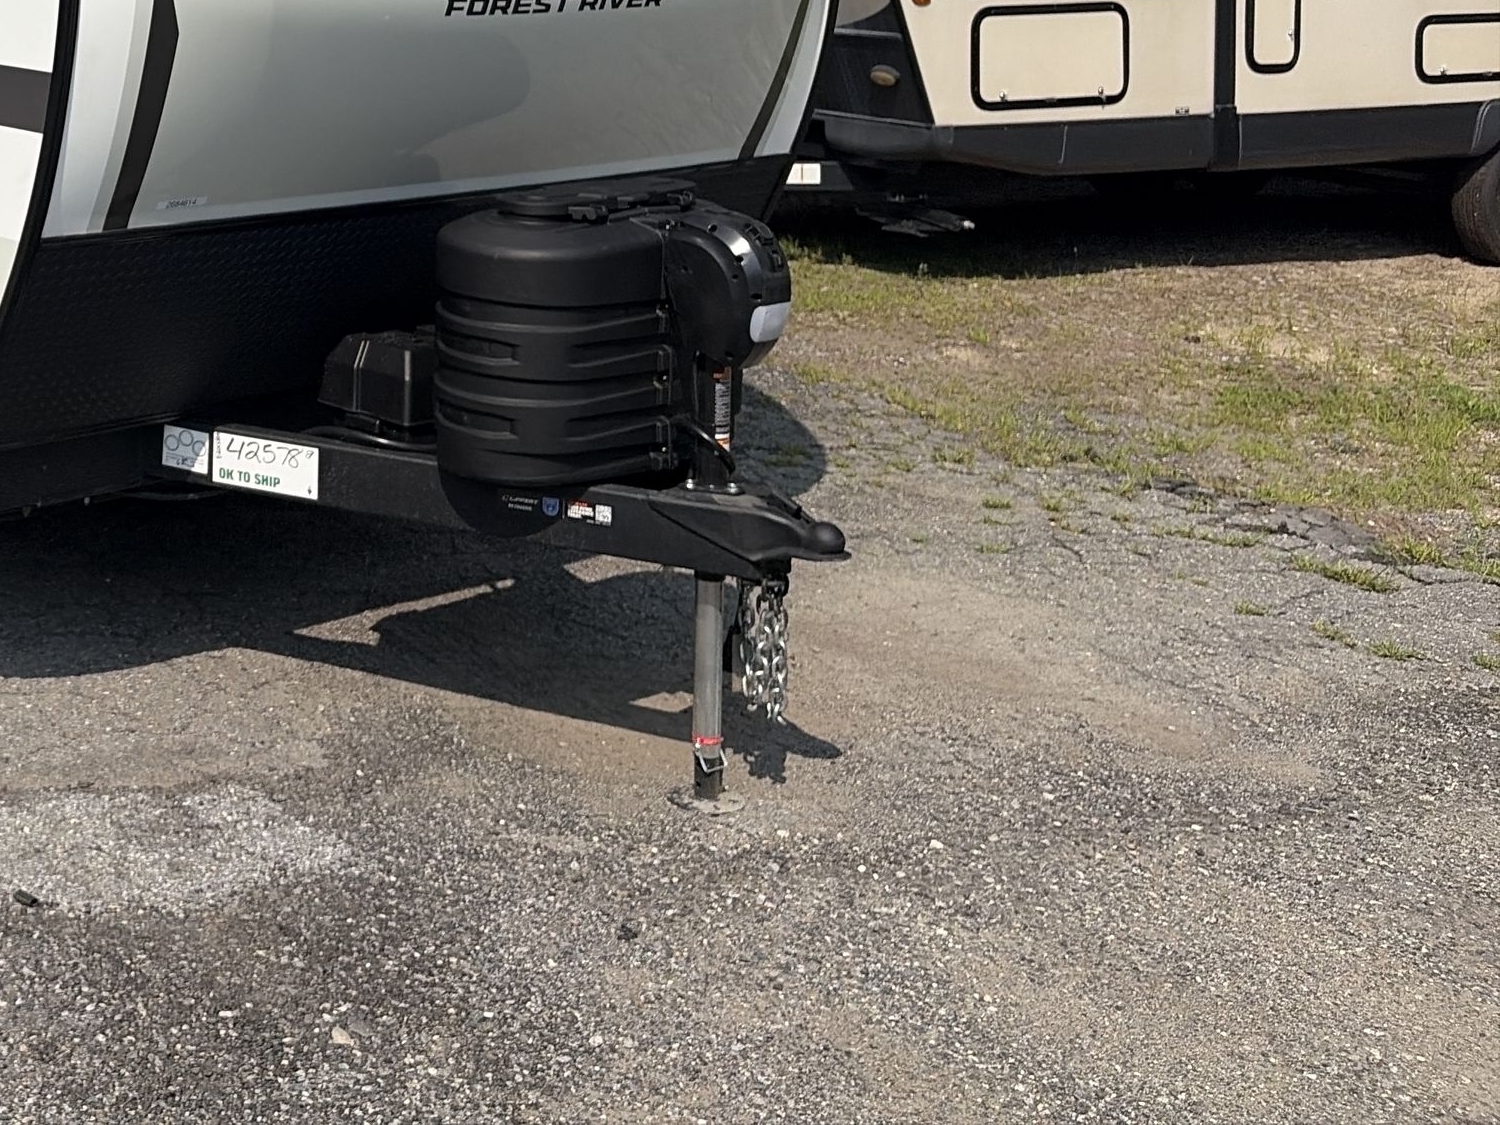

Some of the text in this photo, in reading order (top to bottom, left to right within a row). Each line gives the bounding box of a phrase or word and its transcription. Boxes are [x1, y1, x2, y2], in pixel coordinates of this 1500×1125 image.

[218, 466, 281, 488] OK TO SHIP
